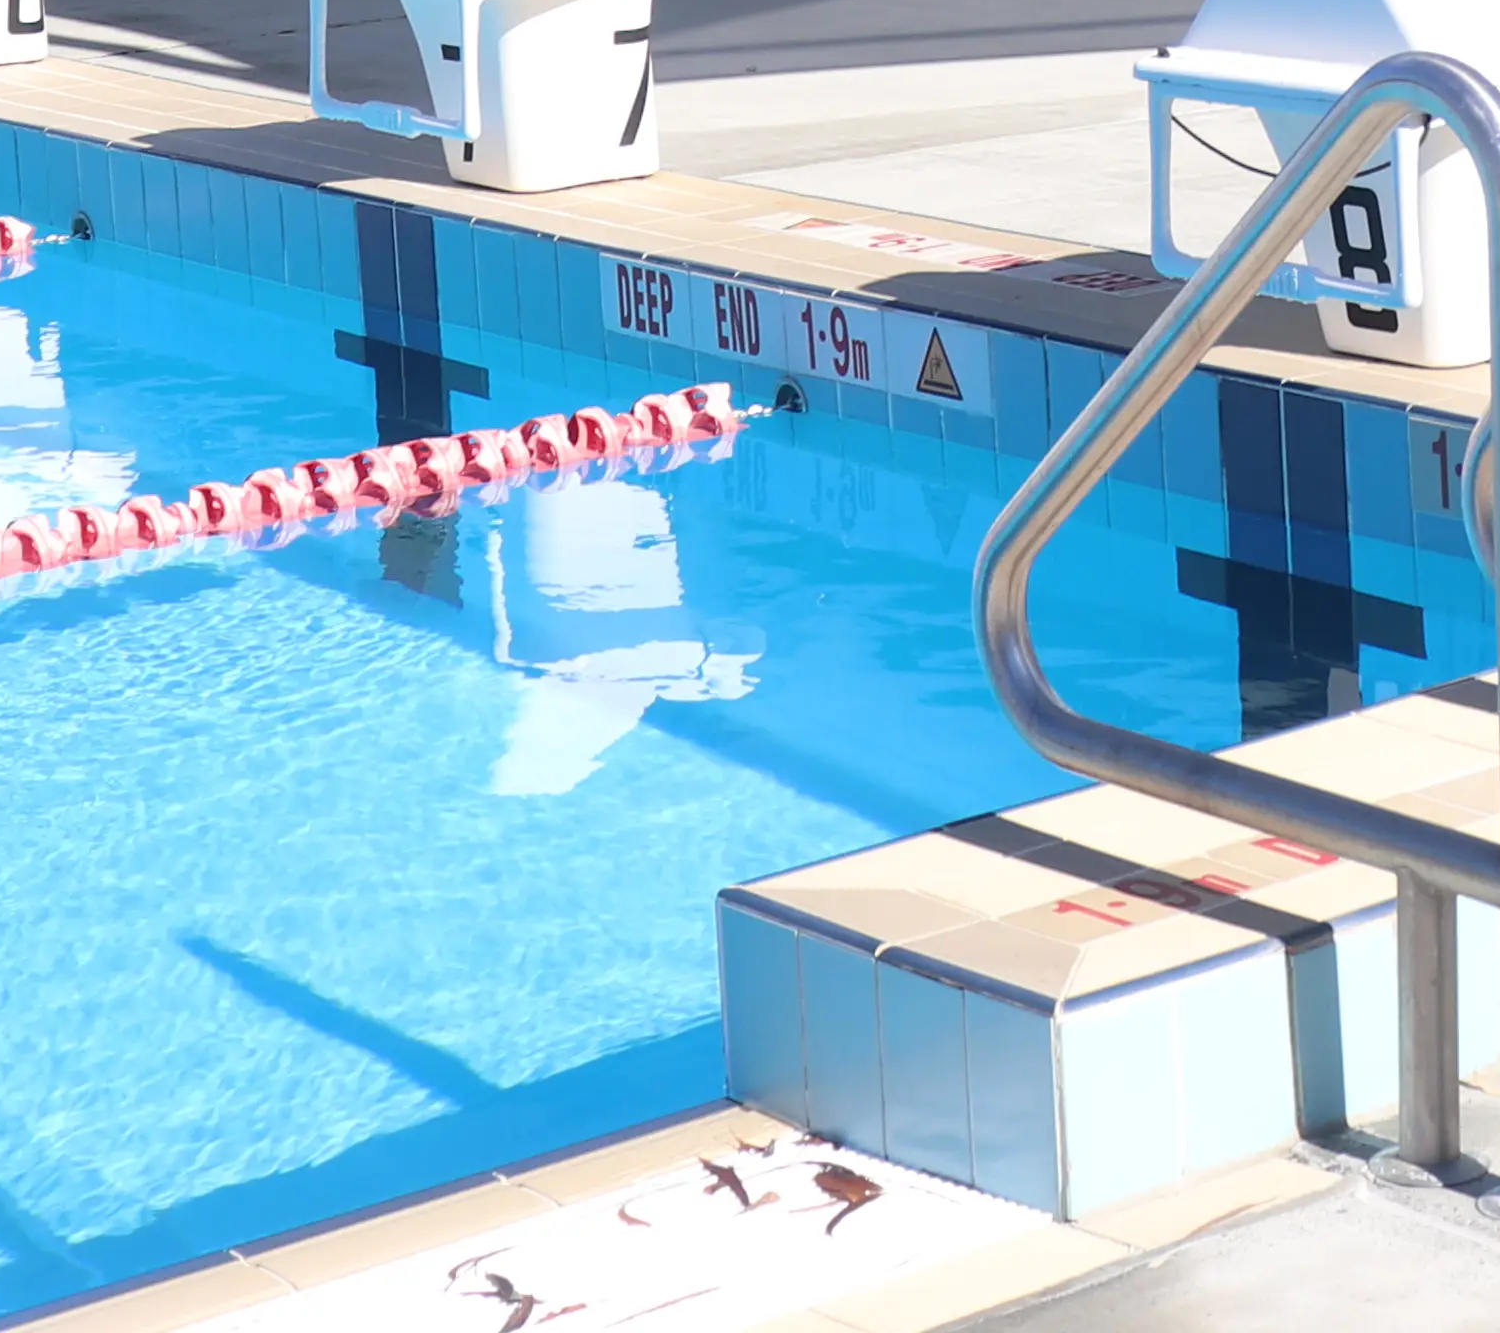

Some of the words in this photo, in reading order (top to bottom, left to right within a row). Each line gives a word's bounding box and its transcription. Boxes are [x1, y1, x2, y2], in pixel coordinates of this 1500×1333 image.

[613, 23, 650, 147] 7
[616, 263, 674, 338] DEEP
[713, 283, 761, 357] END
[1330, 186, 1399, 333] 8
